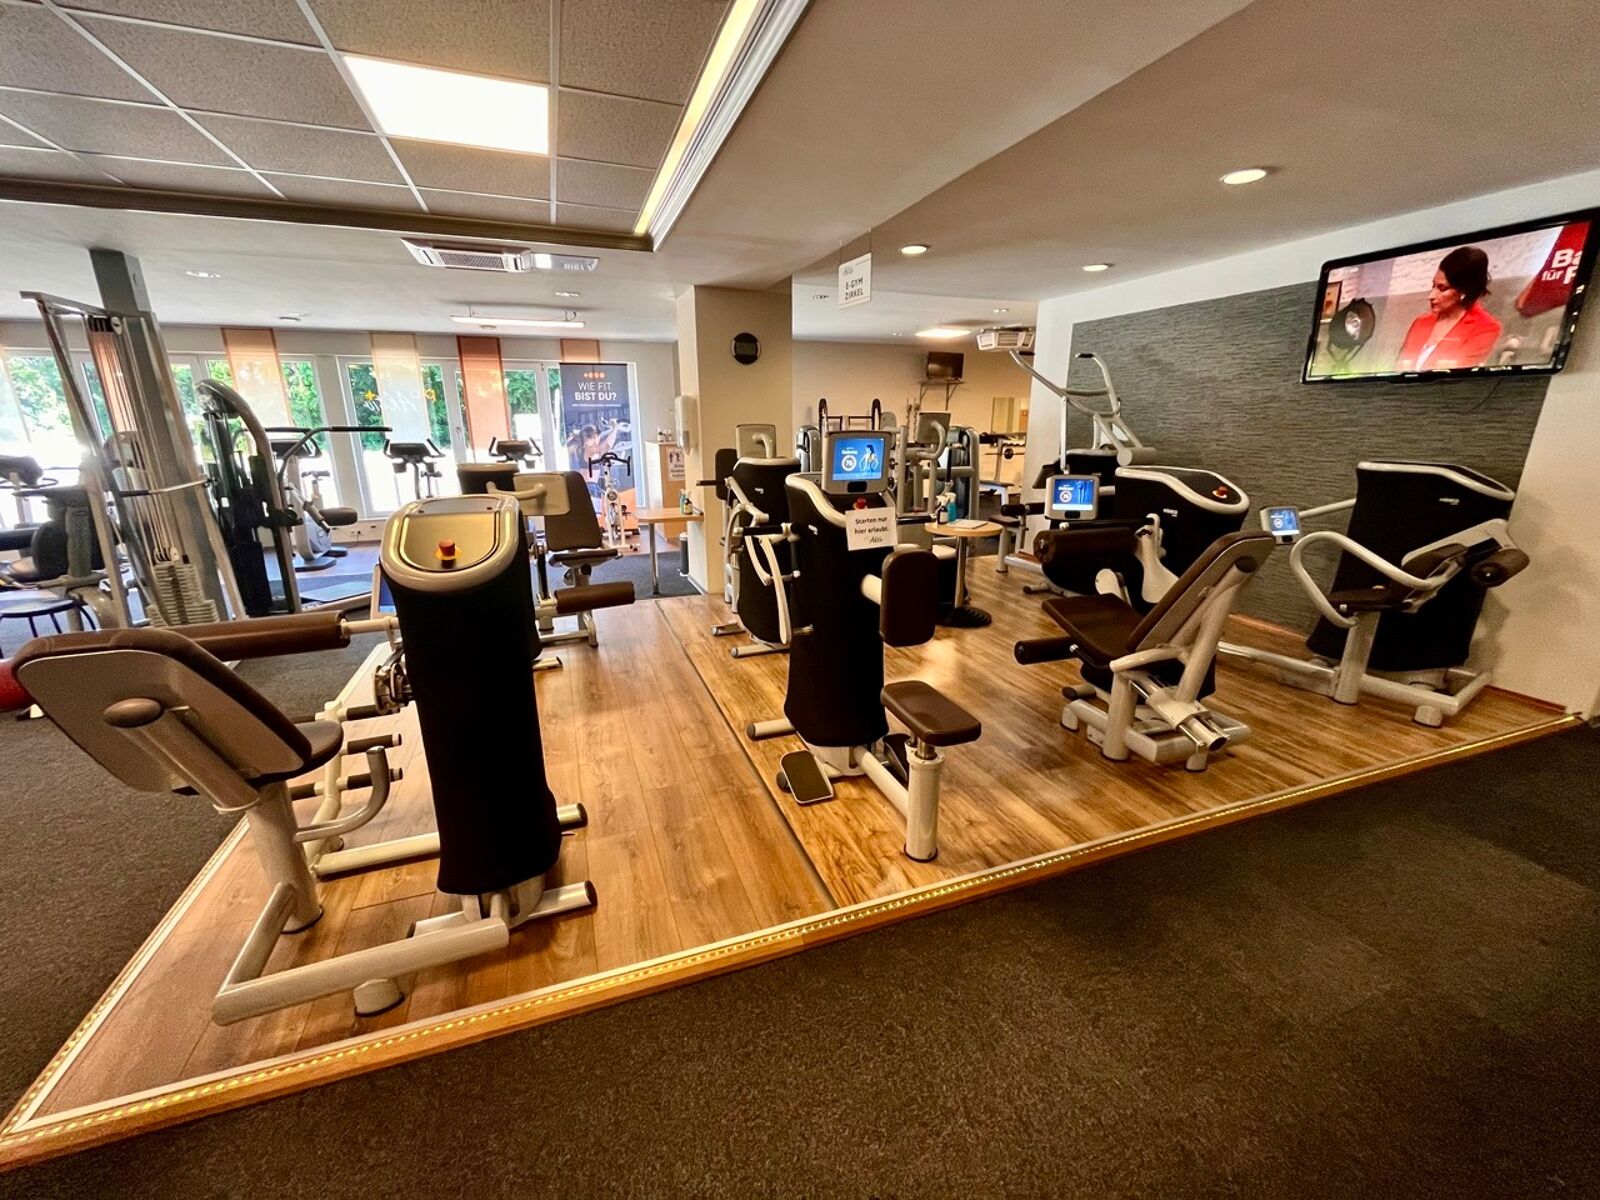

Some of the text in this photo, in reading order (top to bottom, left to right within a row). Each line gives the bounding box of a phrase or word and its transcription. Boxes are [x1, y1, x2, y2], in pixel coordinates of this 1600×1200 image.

[1541, 269, 1564, 281] für
[845, 288, 864, 301] ZIRKEL
[577, 382, 612, 391] WIE FIT
[575, 392, 617, 401] BIST DU?
[855, 517, 877, 525] Starten
[854, 526, 867, 535] hier
